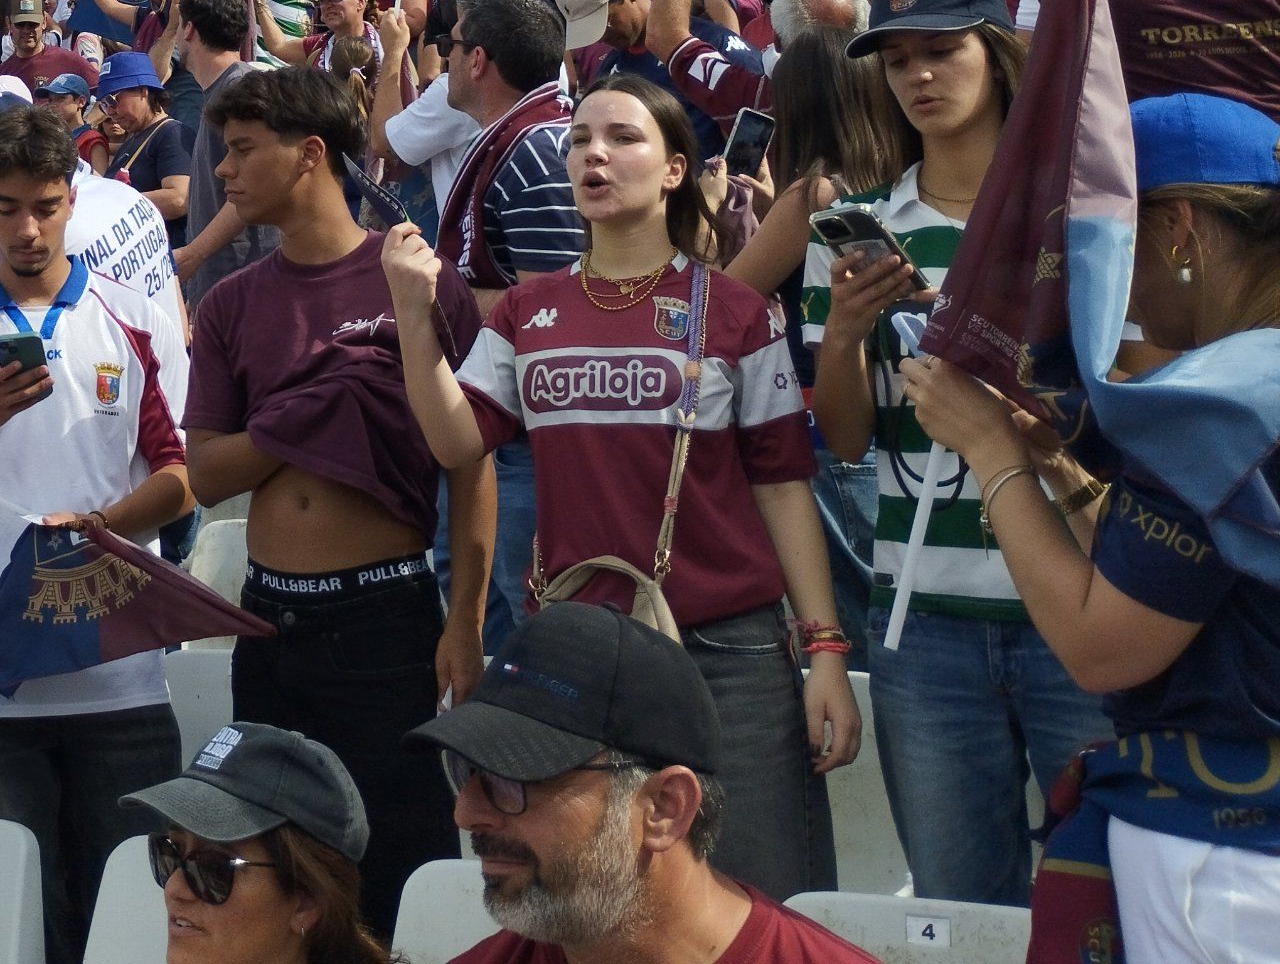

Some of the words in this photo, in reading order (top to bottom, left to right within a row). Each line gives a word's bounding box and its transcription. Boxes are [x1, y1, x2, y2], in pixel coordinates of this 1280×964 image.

[80, 235, 117, 268] INAL
[112, 217, 134, 247] DA
[456, 214, 477, 279] ENSE
[991, 324, 1021, 349] TORREEN
[46, 349, 63, 360] CK
[531, 360, 666, 406] Agriloja
[262, 572, 342, 593] PULL&BEAR
[357, 558, 429, 586] PULL&BEA
[921, 923, 936, 941] 4
